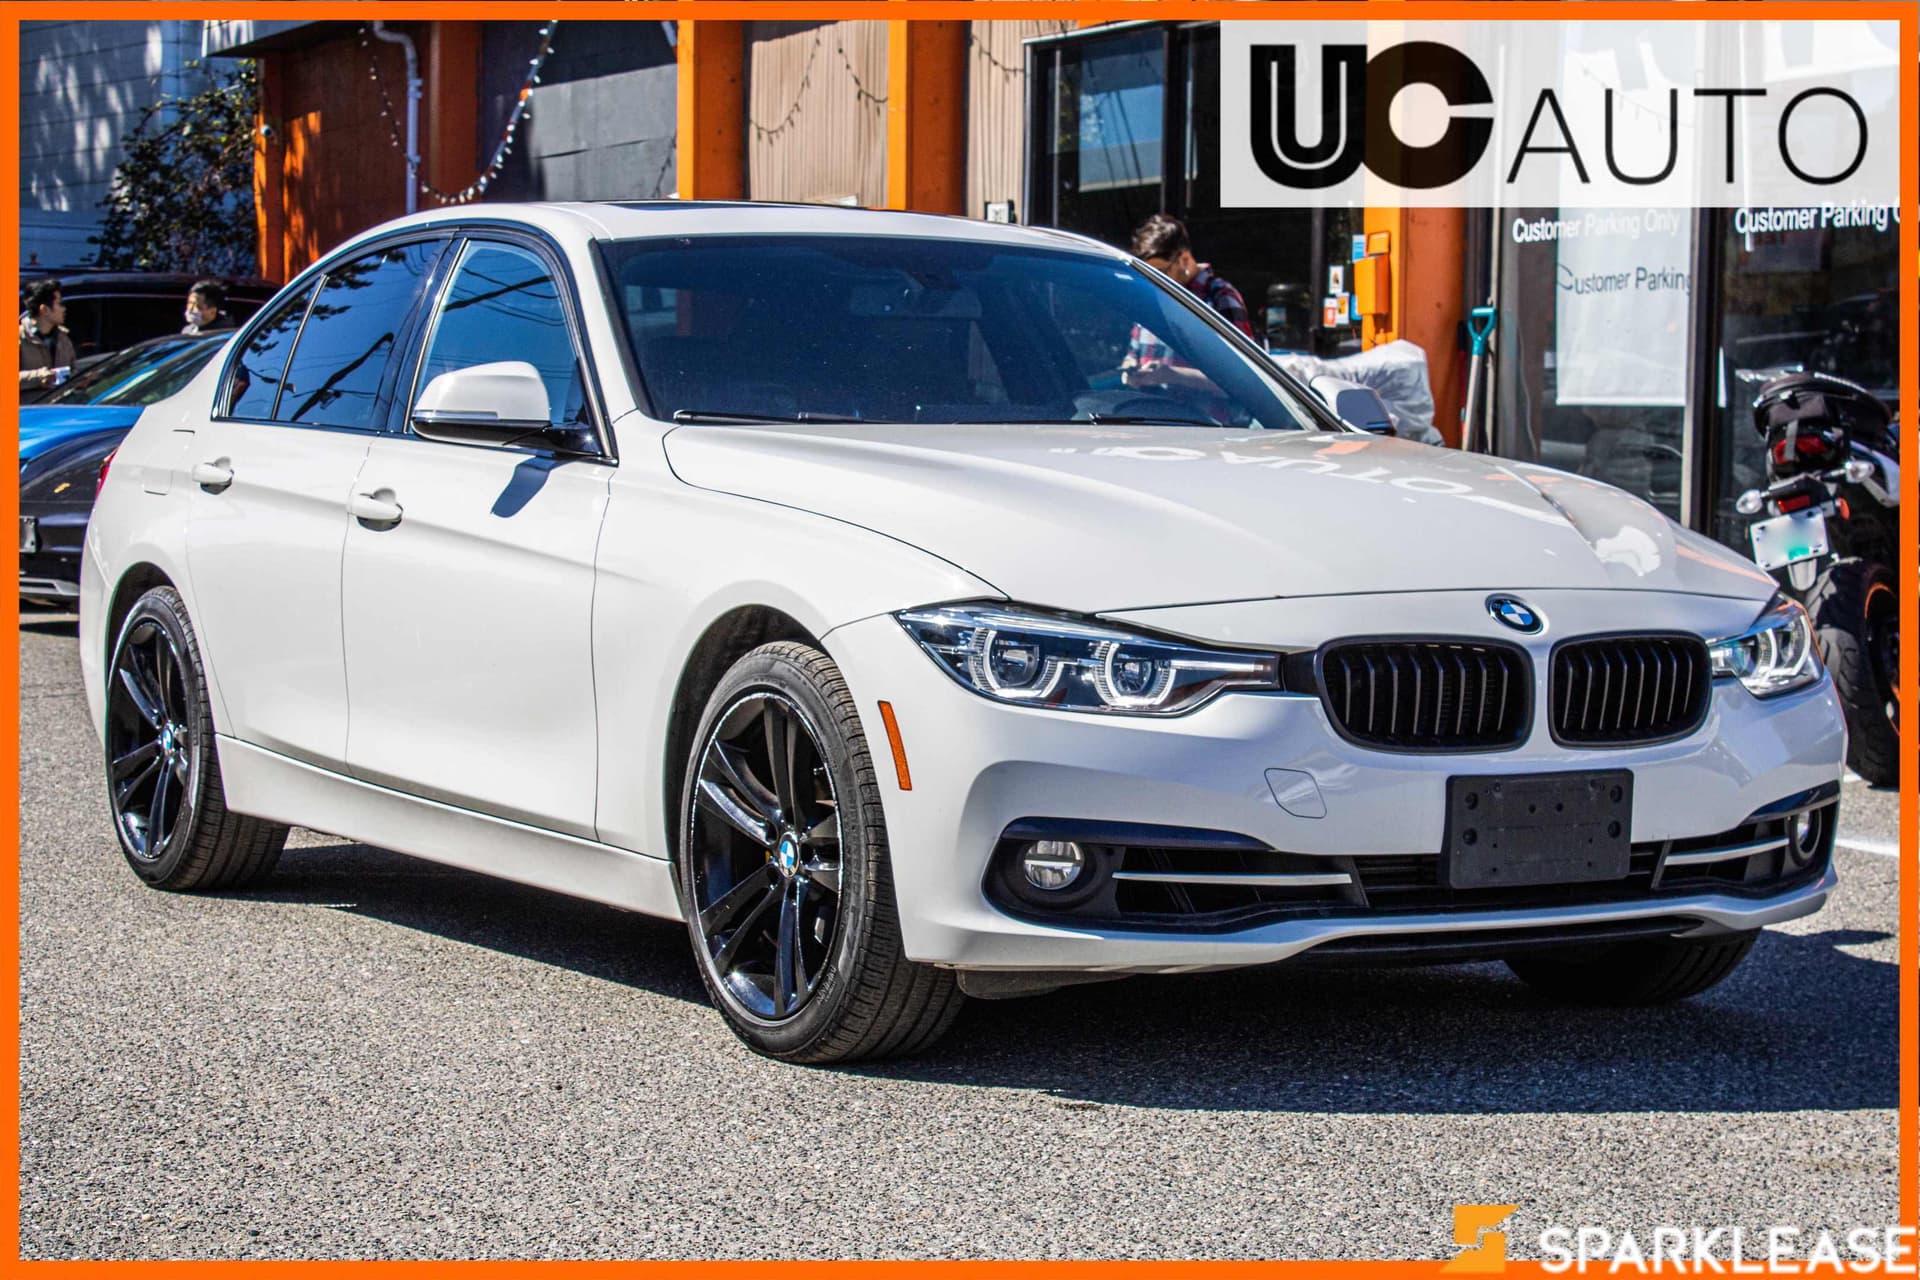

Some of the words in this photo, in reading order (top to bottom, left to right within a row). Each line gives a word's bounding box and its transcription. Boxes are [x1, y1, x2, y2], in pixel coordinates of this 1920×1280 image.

[1513, 217, 1581, 243] Customer
[1585, 212, 1641, 239] Parking
[1645, 208, 1681, 236] Only
[1735, 208, 1818, 234] Customer
[1821, 201, 1889, 232] Parking
